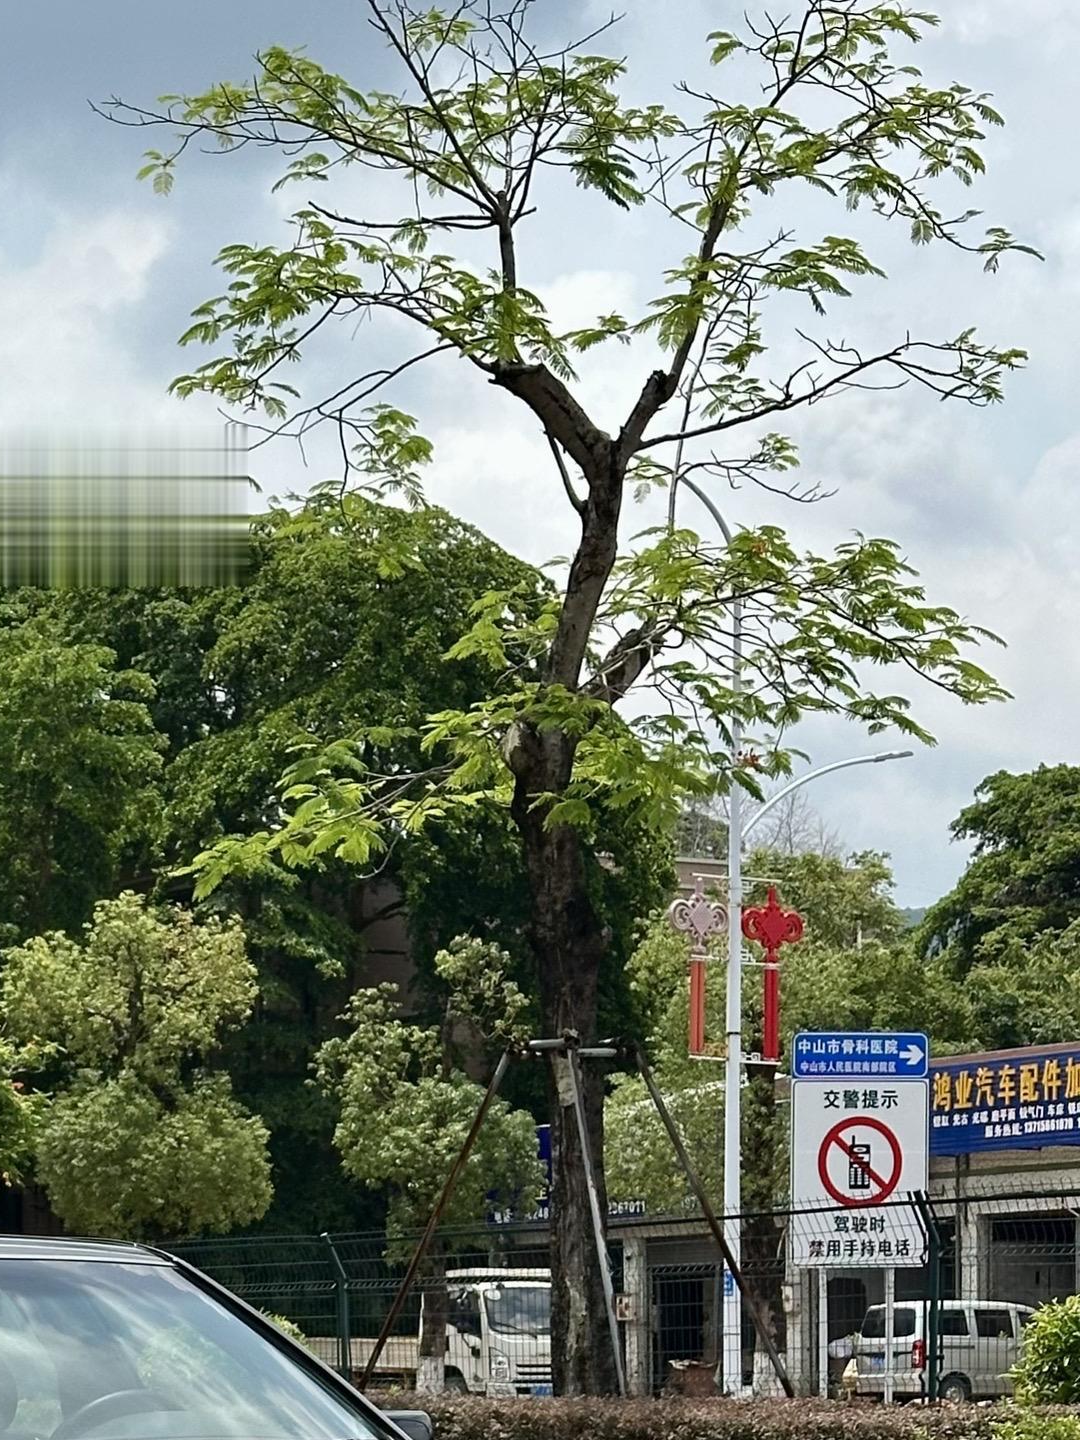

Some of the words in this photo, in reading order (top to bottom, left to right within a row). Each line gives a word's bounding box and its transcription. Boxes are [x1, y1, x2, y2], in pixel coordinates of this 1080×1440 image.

[798, 1039, 899, 1055] 中山市骨科医院
[823, 1089, 899, 1109] 交警提示
[834, 1215, 886, 1233] 驾驶时
[809, 1239, 910, 1257] 禁用手持电话
